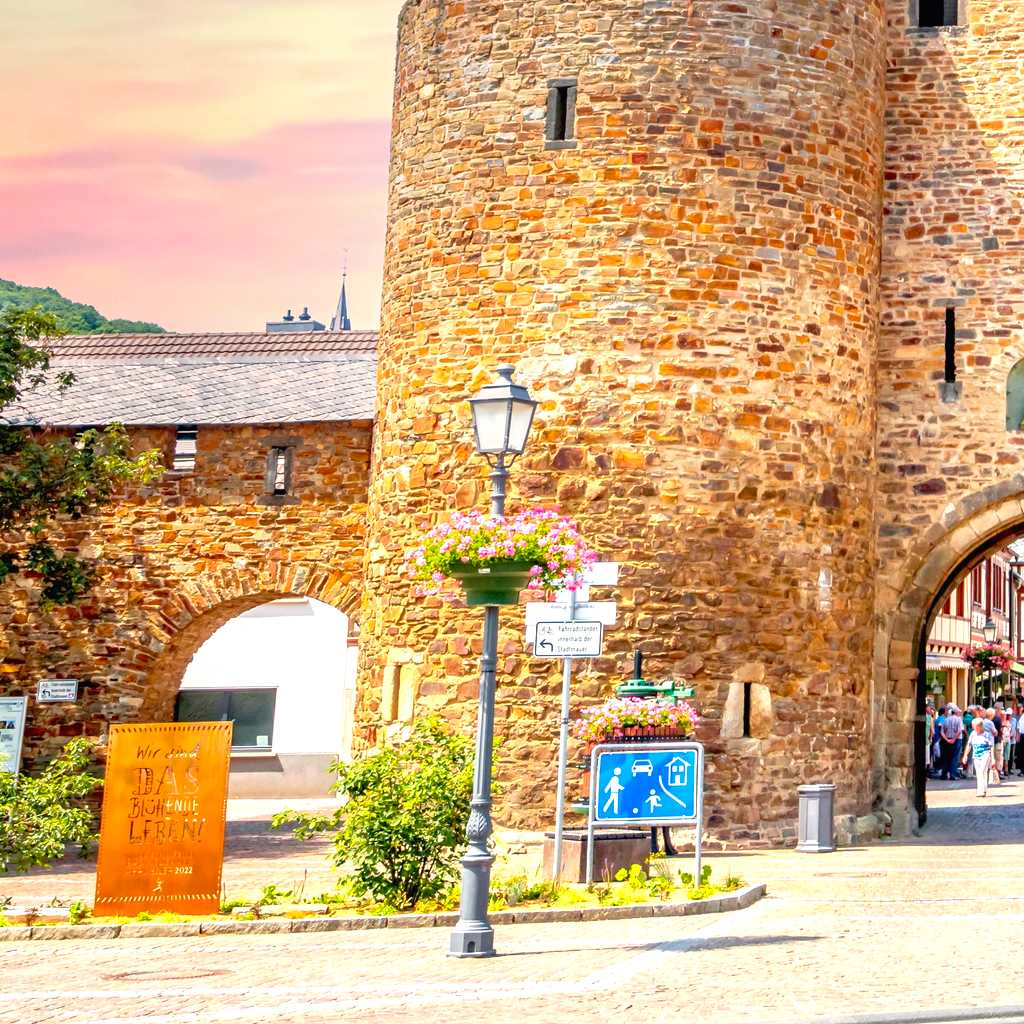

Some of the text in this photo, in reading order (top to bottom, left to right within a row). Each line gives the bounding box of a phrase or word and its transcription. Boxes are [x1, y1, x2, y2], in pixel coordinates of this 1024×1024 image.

[136, 743, 201, 761] Wir sind
[131, 766, 201, 796] DAS
[175, 866, 193, 874] 2022
